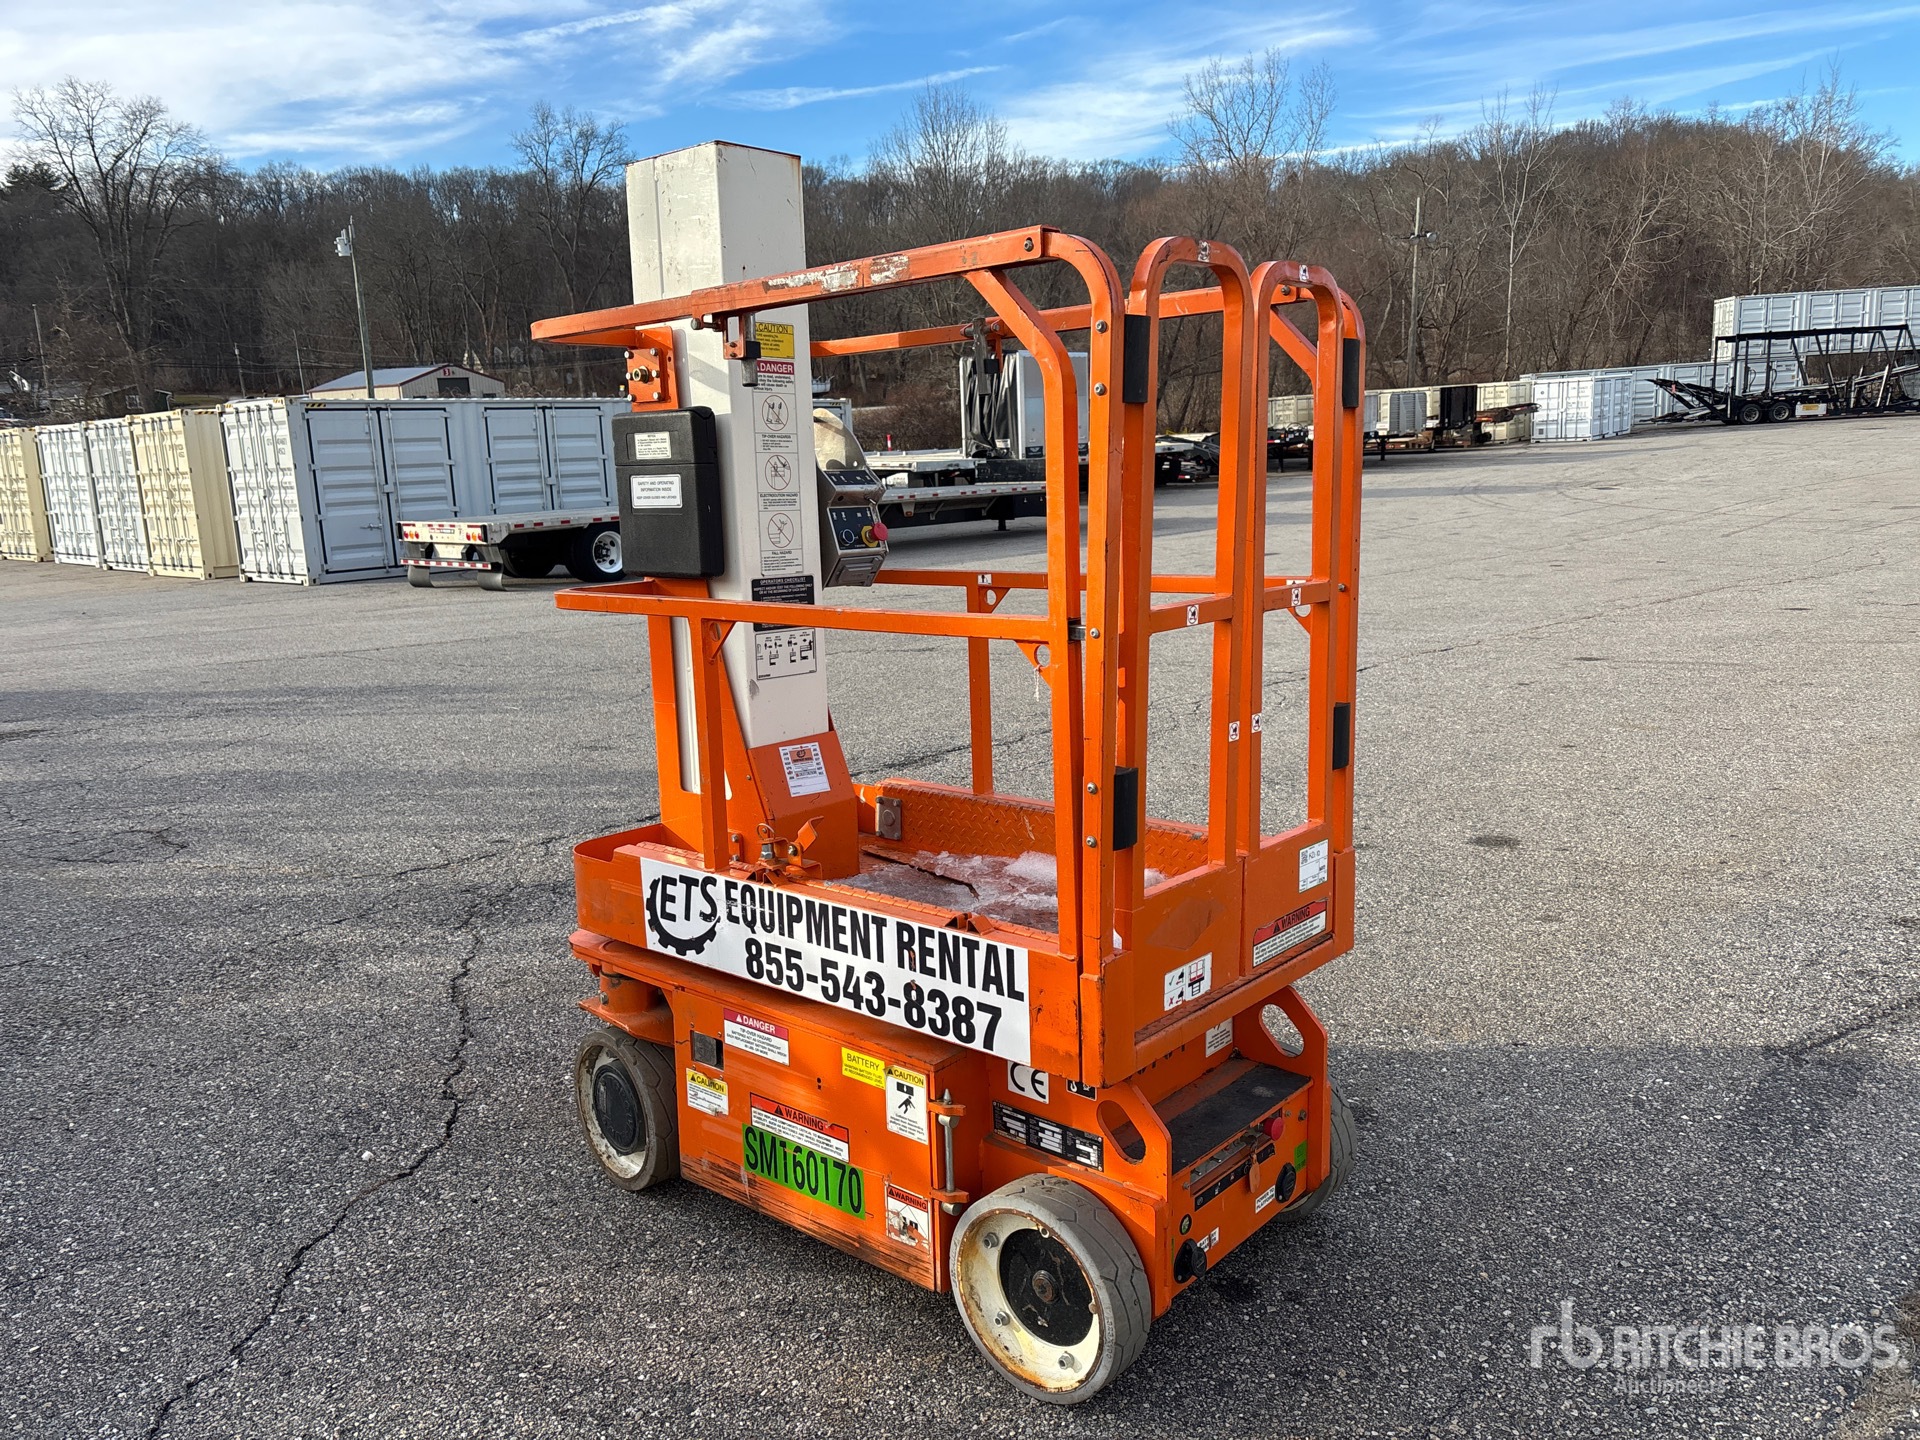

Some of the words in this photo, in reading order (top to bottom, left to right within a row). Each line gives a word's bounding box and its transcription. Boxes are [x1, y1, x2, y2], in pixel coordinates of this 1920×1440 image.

[758, 323, 788, 333] CAUTION
[760, 363, 793, 373] DANGER
[1282, 907, 1310, 928] WARNING
[661, 874, 718, 923] ETS
[724, 879, 887, 963] EQUIPMENT
[896, 921, 1024, 1001] RENTAL
[745, 938, 1002, 1051] 855-543-8387
[743, 1016, 775, 1034] DANGER
[846, 1052, 879, 1071] BATTERY
[894, 1069, 924, 1085] CAUTION
[785, 1108, 824, 1131] WARNING
[745, 1126, 862, 1214] SM160170
[895, 1191, 926, 1209] WARNING
[1256, 1191, 1268, 1204] POWER
